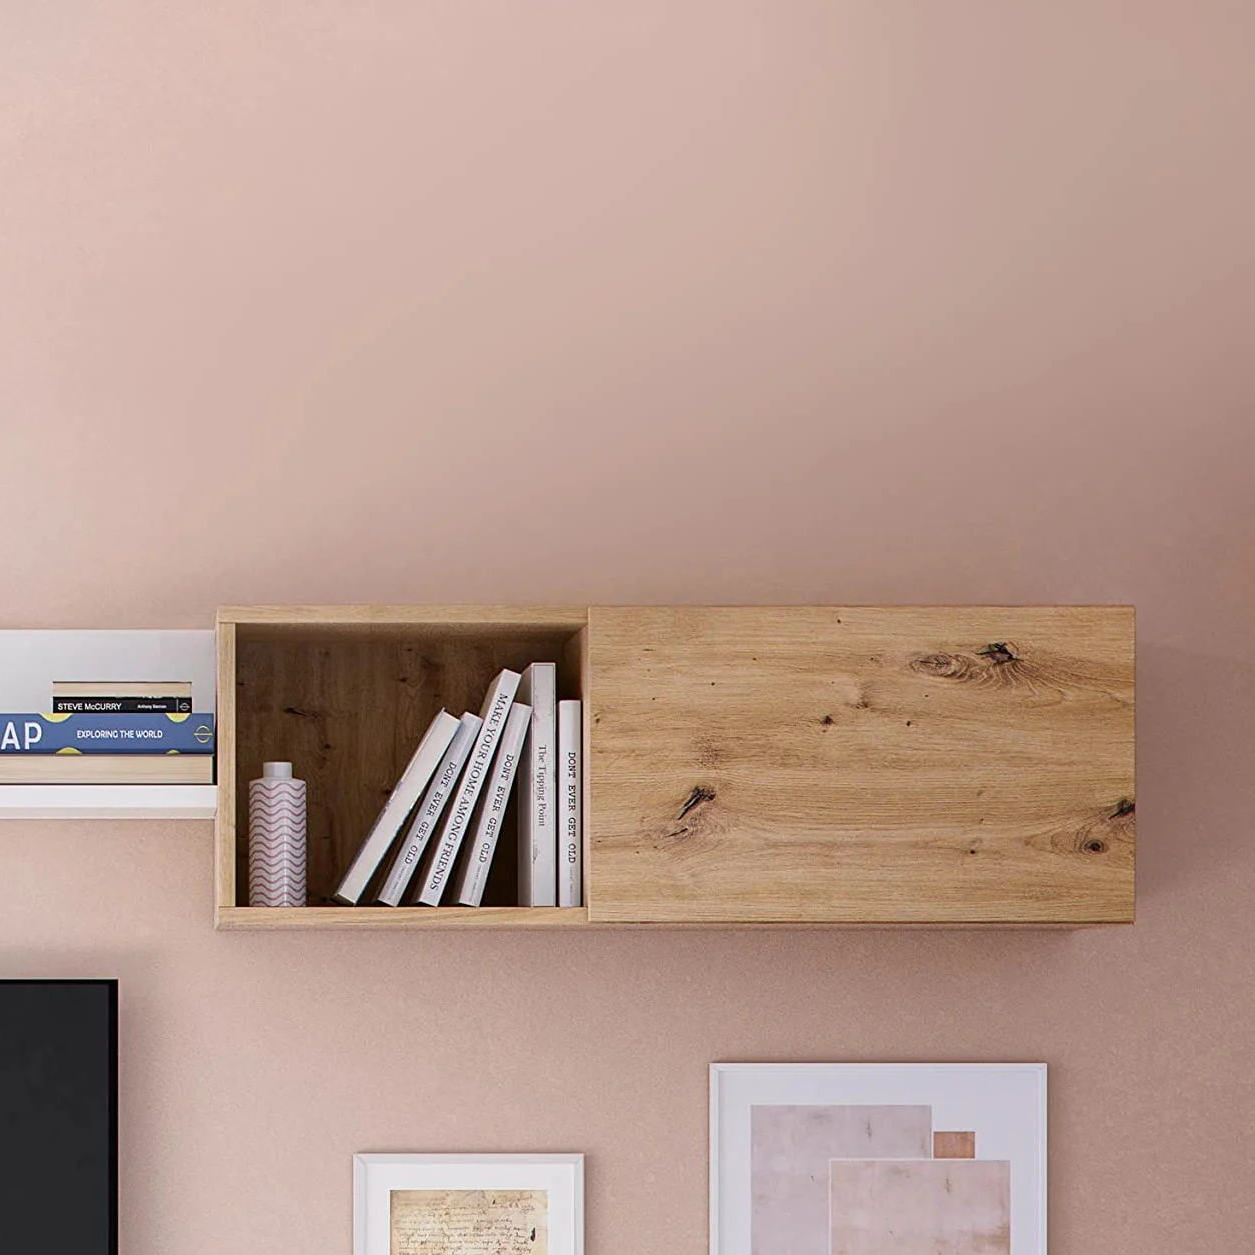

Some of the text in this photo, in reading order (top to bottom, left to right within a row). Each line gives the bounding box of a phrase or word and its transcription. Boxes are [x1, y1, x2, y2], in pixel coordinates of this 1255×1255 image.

[57, 702, 122, 711] STEVE McCURRY
[76, 729, 163, 739] EXPLORING THE WORLD
[568, 752, 577, 778] DONT
[429, 692, 509, 891] MAKE YOUR HOME AMONG FRIENDS
[537, 744, 547, 827] The Tipping Point
[568, 784, 577, 811] EVER
[404, 761, 457, 865] DONT EVER GET OLD
[478, 754, 514, 863] DONT EVER GET OLD
[568, 817, 577, 837] GET
[568, 843, 577, 863] OLD
